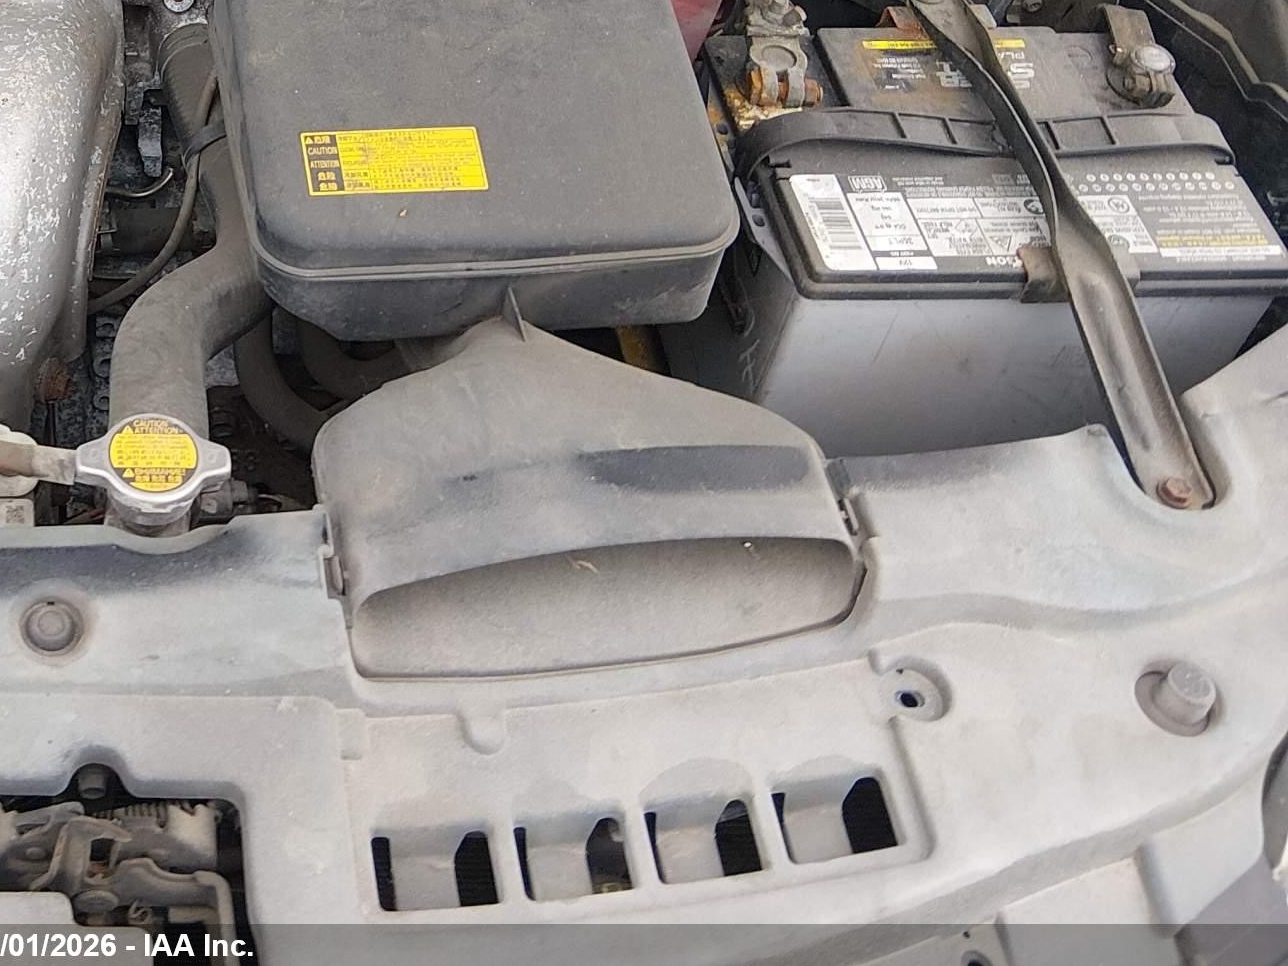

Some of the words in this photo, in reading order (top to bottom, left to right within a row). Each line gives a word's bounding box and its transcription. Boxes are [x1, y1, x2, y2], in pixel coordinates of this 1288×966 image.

[307, 146, 338, 155] CAUTION
[132, 418, 169, 427] CAUTION
[134, 426, 179, 434] ATTENTION
